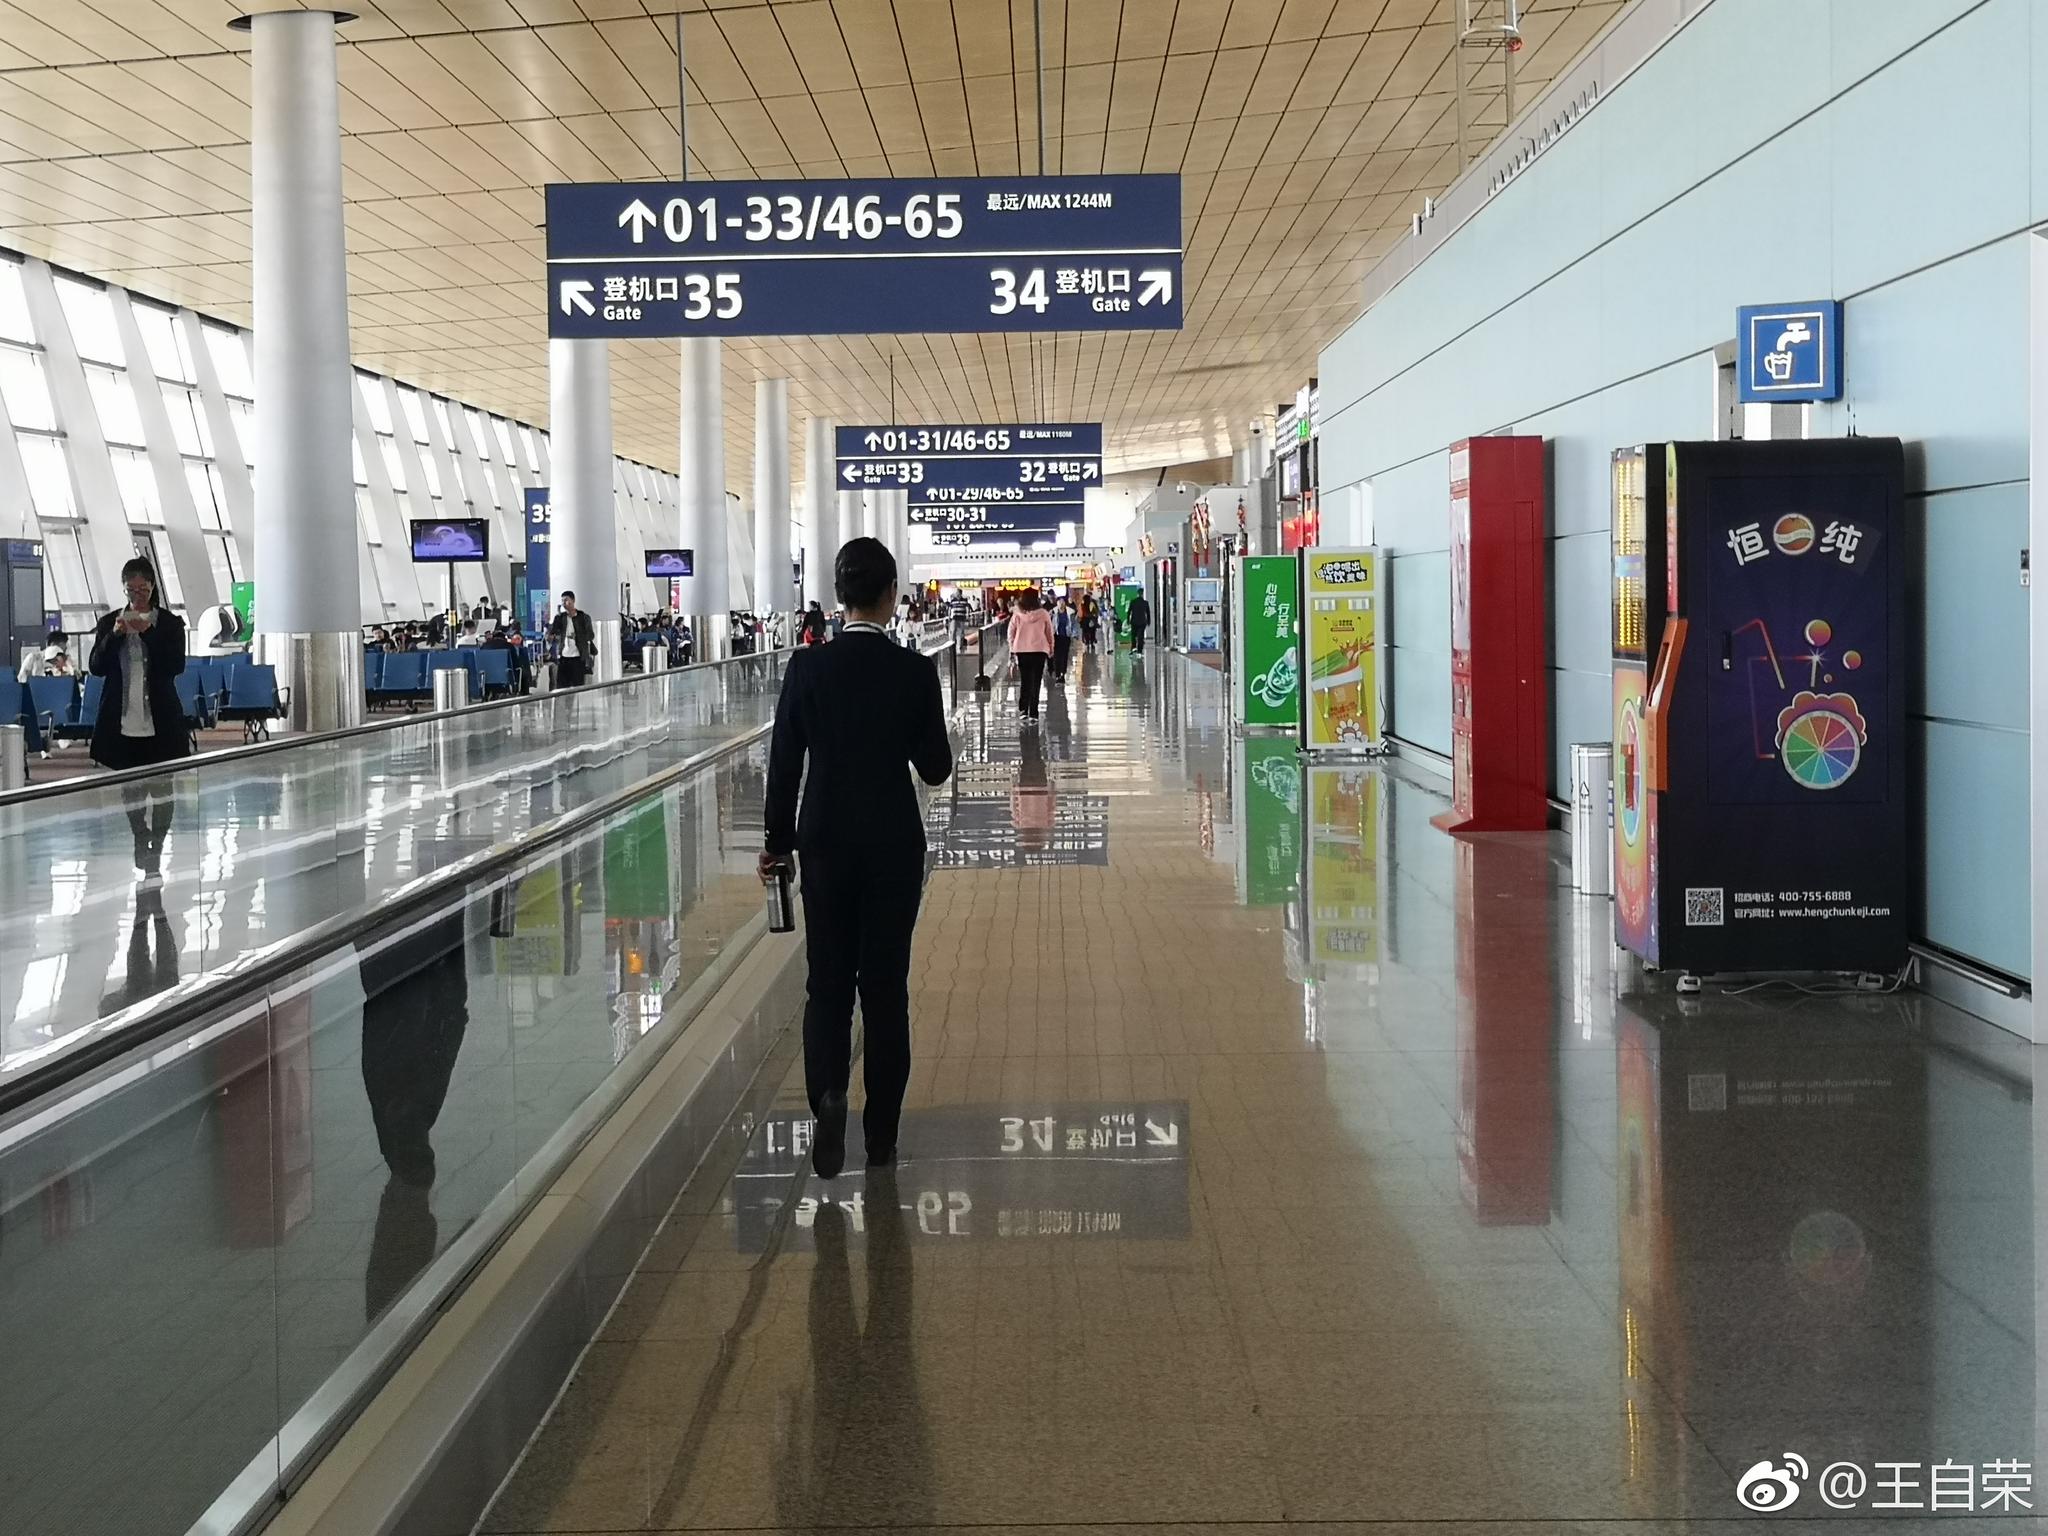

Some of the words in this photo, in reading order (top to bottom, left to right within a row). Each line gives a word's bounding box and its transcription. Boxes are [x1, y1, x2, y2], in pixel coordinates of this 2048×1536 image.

[986, 193, 1061, 210] 最远/MAX
[1064, 193, 1111, 208] 1244M
[663, 194, 964, 242] 01-33/46-65
[603, 275, 679, 302] 登机口
[684, 273, 743, 319] 35
[989, 268, 1050, 314] 34
[1055, 268, 1131, 294] 登机口
[603, 305, 642, 320] Gate
[1092, 297, 1131, 312] Gate
[882, 430, 1011, 451] 01-31/46-65
[863, 463, 897, 475] 登机口
[897, 461, 924, 483] 33
[1019, 461, 1046, 482] 32
[946, 506, 987, 522] 30-31
[1726, 522, 1770, 566] 恒
[1819, 520, 1863, 564] 纯
[1778, 891, 1852, 901] 400-755-6888
